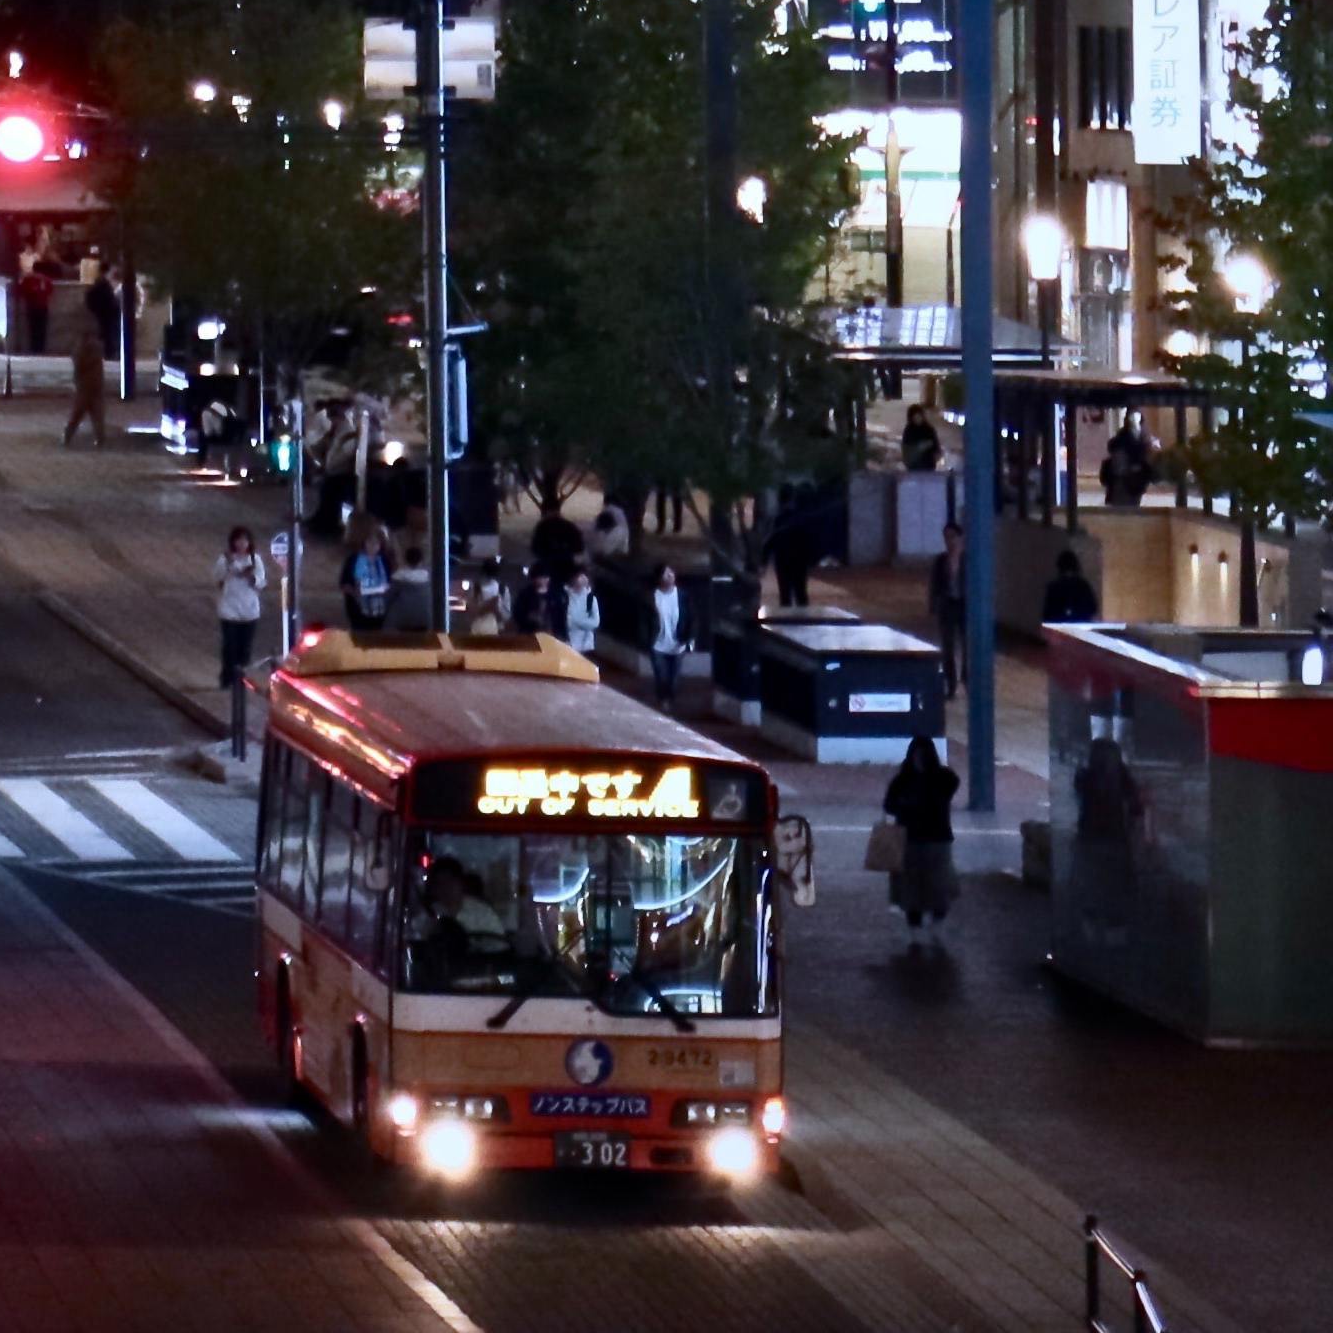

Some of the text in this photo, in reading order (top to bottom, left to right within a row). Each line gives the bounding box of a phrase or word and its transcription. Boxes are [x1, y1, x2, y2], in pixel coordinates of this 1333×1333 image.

[478, 796, 700, 819] OUT OF SERVICE
[533, 1096, 649, 1115] ノンステップバス
